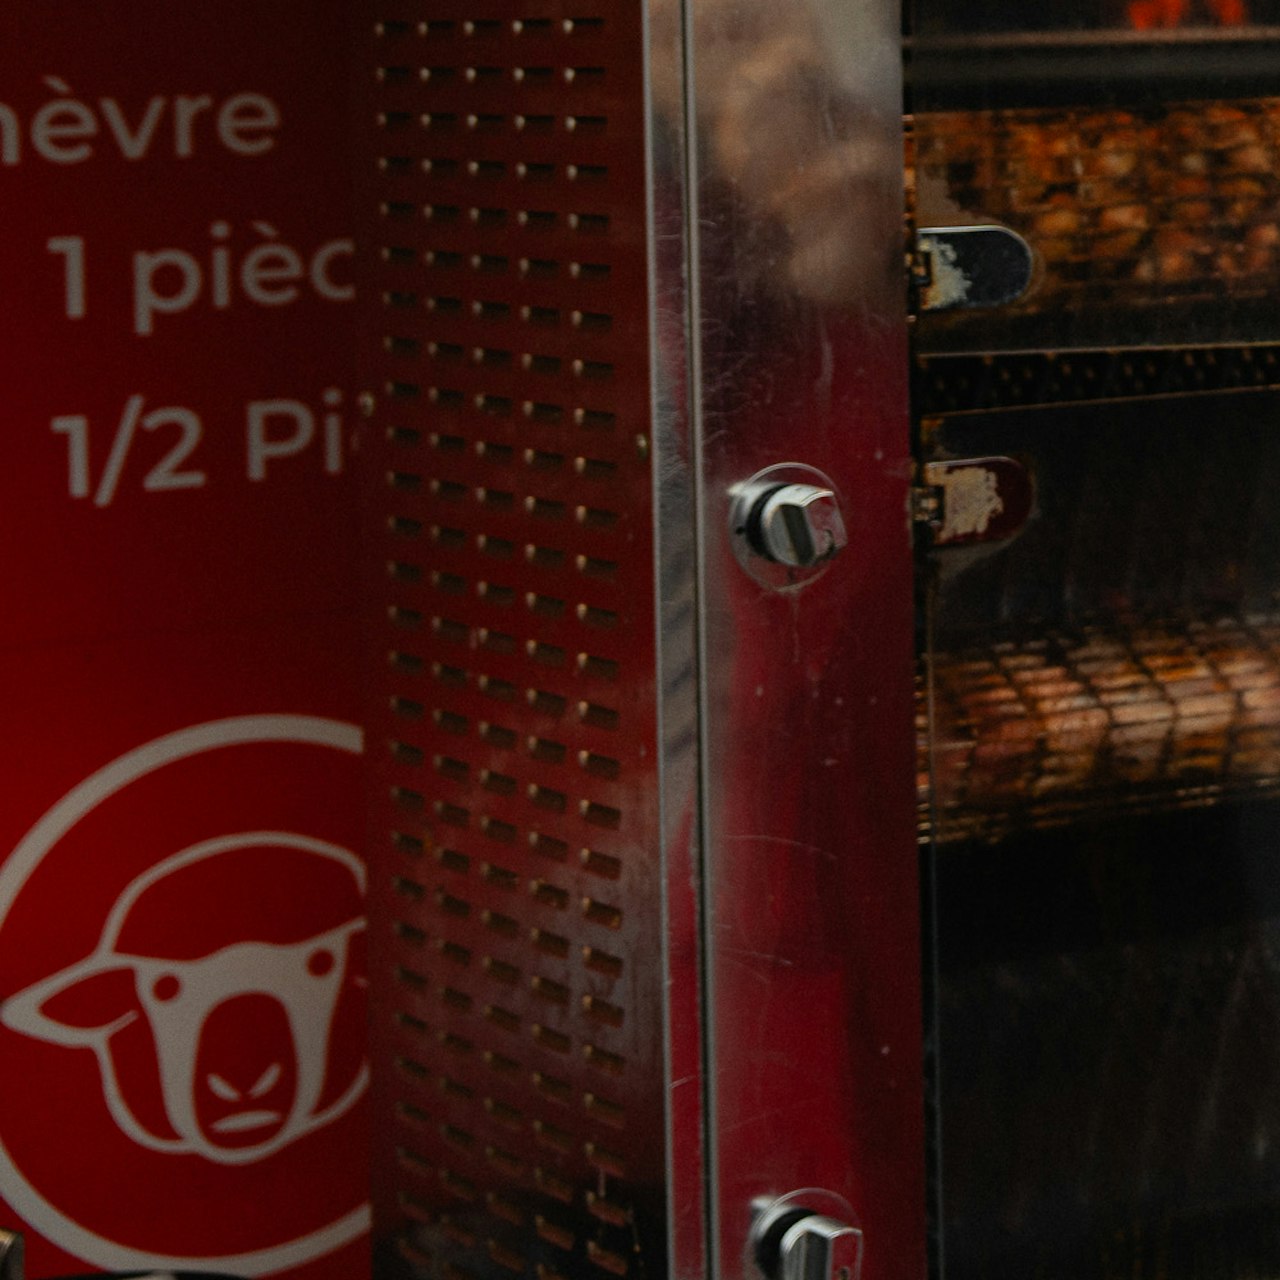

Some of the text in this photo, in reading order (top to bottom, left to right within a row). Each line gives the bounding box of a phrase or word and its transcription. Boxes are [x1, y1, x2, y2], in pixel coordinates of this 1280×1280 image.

[47, 222, 356, 336] 1 pièc
[51, 388, 342, 506] 1/2 Pi
